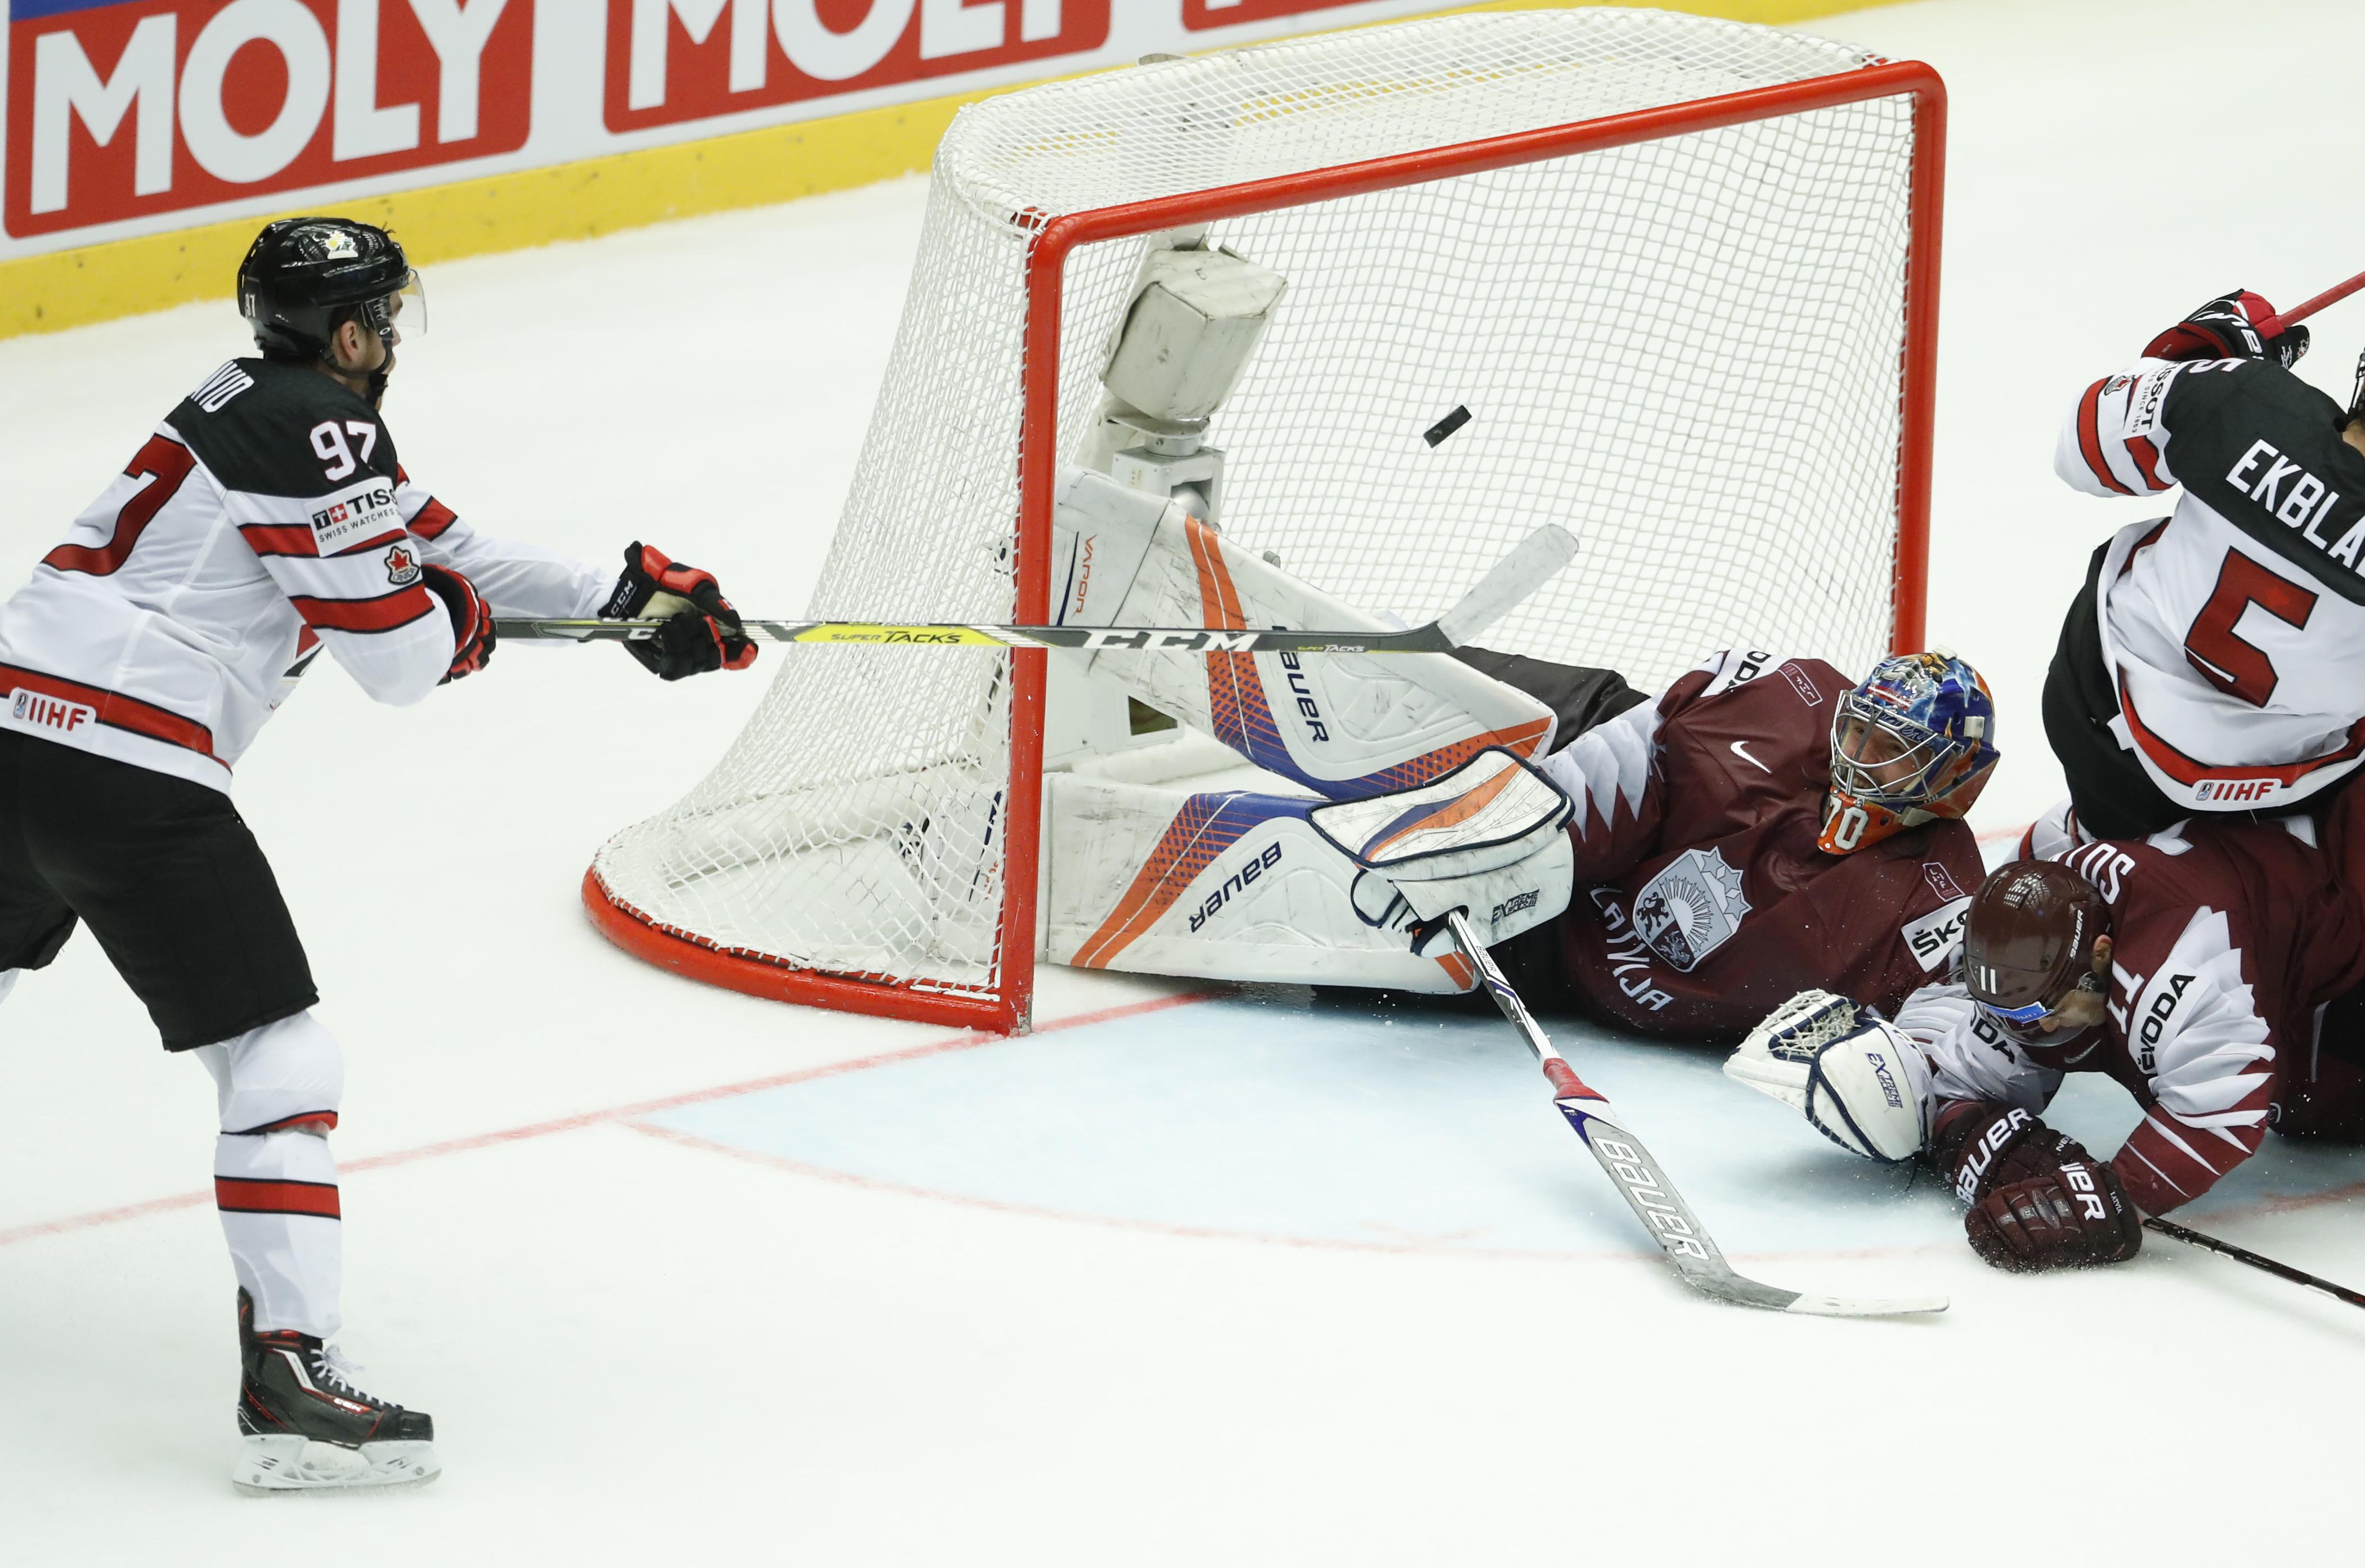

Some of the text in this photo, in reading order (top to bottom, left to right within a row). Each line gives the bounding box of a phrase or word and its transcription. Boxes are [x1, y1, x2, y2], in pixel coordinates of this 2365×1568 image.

[31, 0, 506, 215] MOLY
[2138, 386, 2151, 411] SINCE
[310, 421, 377, 481] 97
[40, 433, 197, 577] 7
[319, 509, 395, 543] SWISS WATCHES
[2225, 438, 2365, 579] EKBLA
[610, 580, 634, 616] CCM
[1070, 534, 1098, 619] VAPOR
[884, 630, 963, 643] TACKS
[1081, 630, 1260, 652] CCM
[2185, 546, 2319, 708] 5
[1271, 625, 1329, 742] AUER
[29, 696, 88, 732] IIHF
[2213, 781, 2274, 801] IIHF
[1820, 796, 1869, 850] 70
[1189, 841, 1282, 933] BAUER
[1476, 946, 1497, 972] BAUER
[1590, 887, 1675, 1011] LATVIJA
[2070, 909, 2084, 960] BAUER
[1980, 965, 1997, 994] 11
[1956, 1108, 2033, 1205] BAUER
[1592, 1137, 1710, 1260] BAUER
[2109, 1191, 2122, 1215] LATVIA
